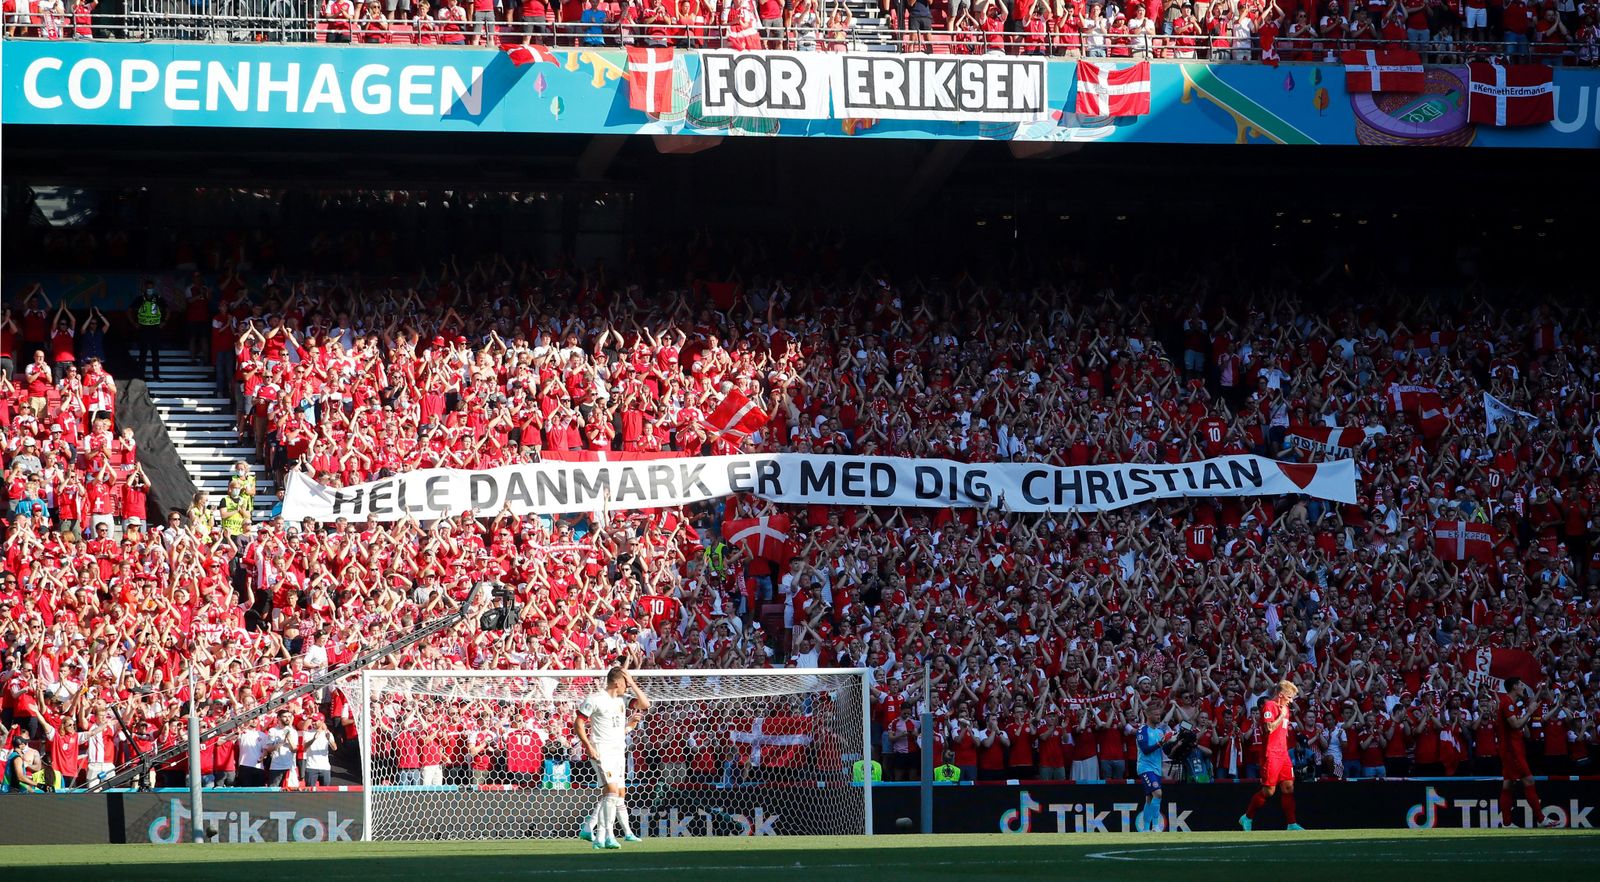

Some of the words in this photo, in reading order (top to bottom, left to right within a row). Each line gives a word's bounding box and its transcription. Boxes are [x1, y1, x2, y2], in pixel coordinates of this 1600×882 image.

[23, 56, 484, 116] COPENHAGEN
[703, 52, 806, 111] FOR
[841, 54, 1046, 113] ERIKSEN
[1473, 83, 1546, 96] #KennethErdmann
[1208, 427, 1221, 442] 10
[333, 476, 450, 515] HELE
[469, 462, 713, 511] DANMARK
[727, 460, 783, 496] ER
[800, 460, 897, 498] MED
[1020, 458, 1264, 507] CHRISTIAN
[1193, 529, 1205, 545] 10
[650, 599, 664, 615] 10
[515, 734, 531, 746] 10
[202, 809, 356, 844] TikTok
[1049, 802, 1194, 833] TikTok
